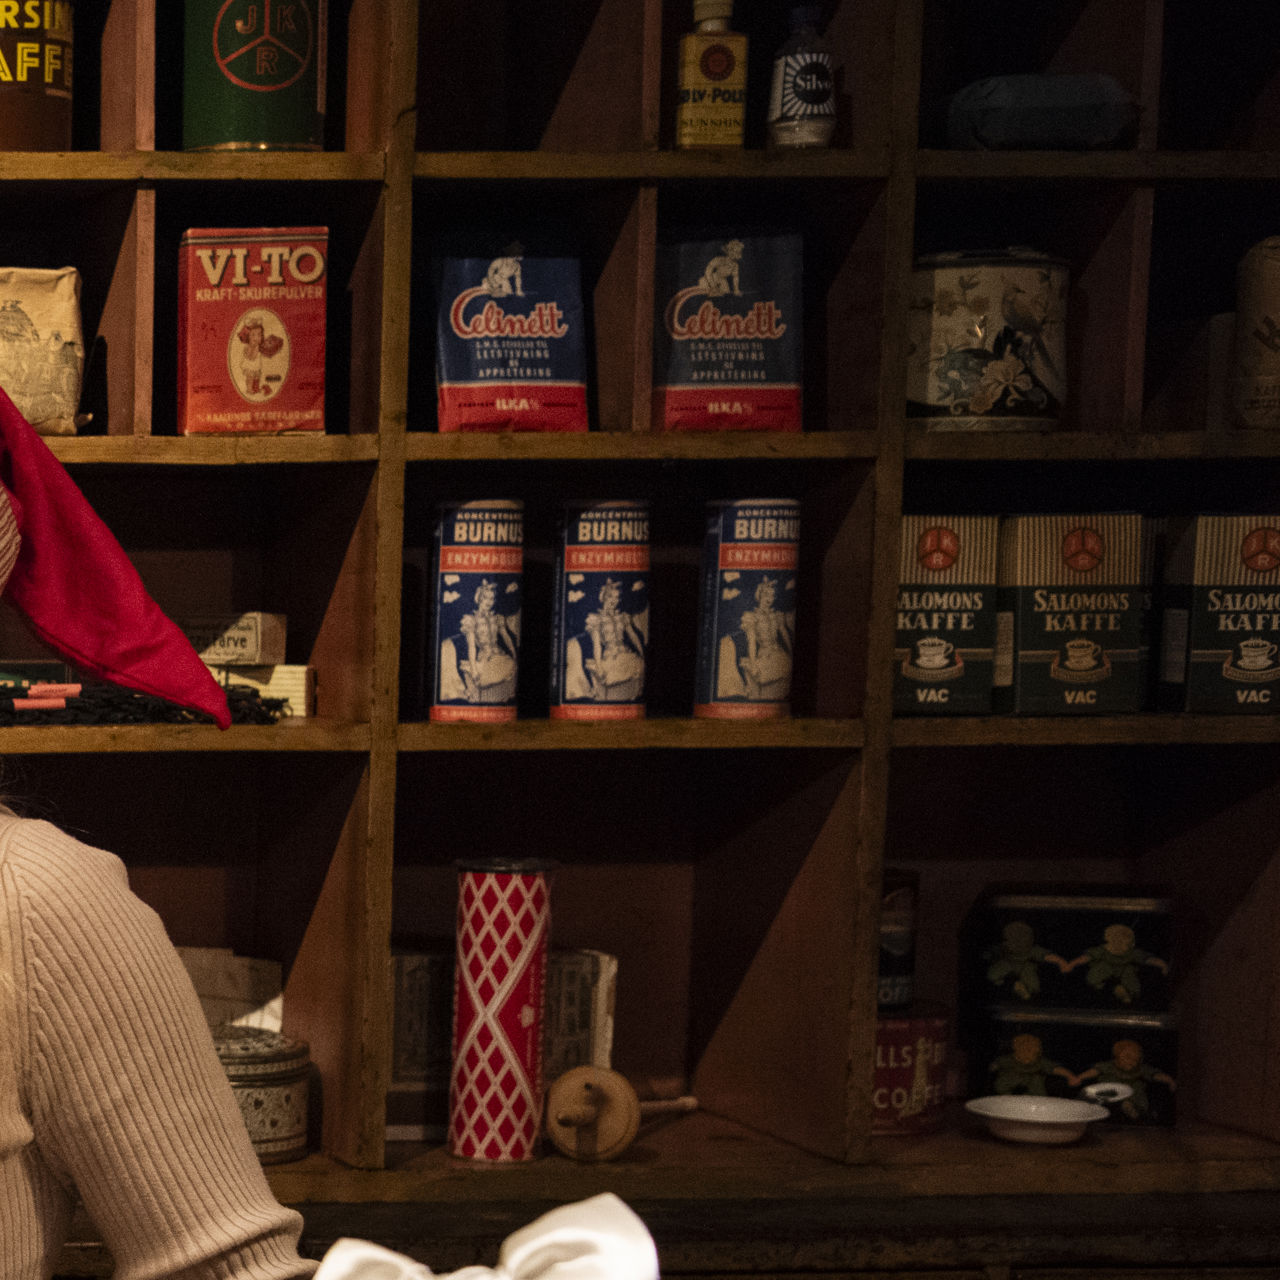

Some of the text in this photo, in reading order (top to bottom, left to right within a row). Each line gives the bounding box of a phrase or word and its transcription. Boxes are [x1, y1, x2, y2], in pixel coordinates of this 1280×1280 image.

[794, 74, 833, 91] Silvo
[196, 245, 326, 287] VI-TO
[449, 285, 569, 340] Celinett
[664, 285, 787, 341] Celinett
[454, 521, 523, 543] BURNUS
[578, 521, 649, 542] BURNUS
[734, 519, 799, 540] BURNU
[899, 591, 983, 611] ALOMONS
[1034, 589, 1129, 611] SALOMONS
[896, 612, 975, 631] KAFFE
[1044, 613, 1120, 631] KAFFE
[916, 688, 949, 703] VAC
[1064, 690, 1097, 704] VAC
[1235, 689, 1271, 704] VAC
